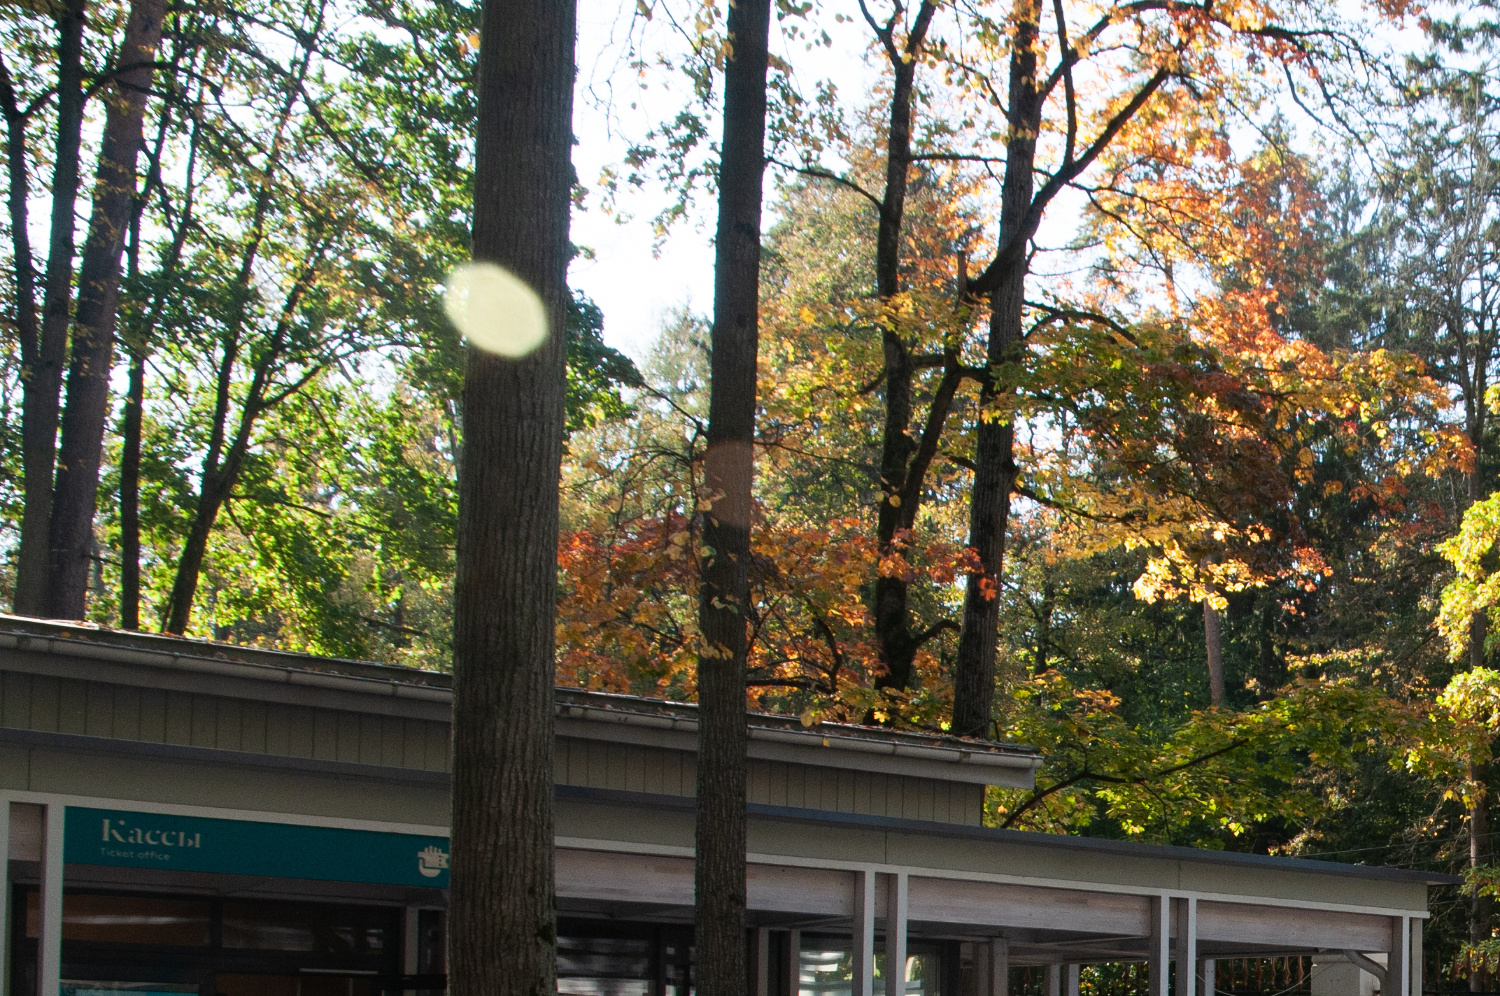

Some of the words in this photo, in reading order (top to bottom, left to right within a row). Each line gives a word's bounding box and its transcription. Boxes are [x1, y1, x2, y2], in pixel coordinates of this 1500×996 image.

[101, 818, 201, 848] Кассы
[100, 847, 134, 858] Ticket
[137, 850, 171, 861] office
